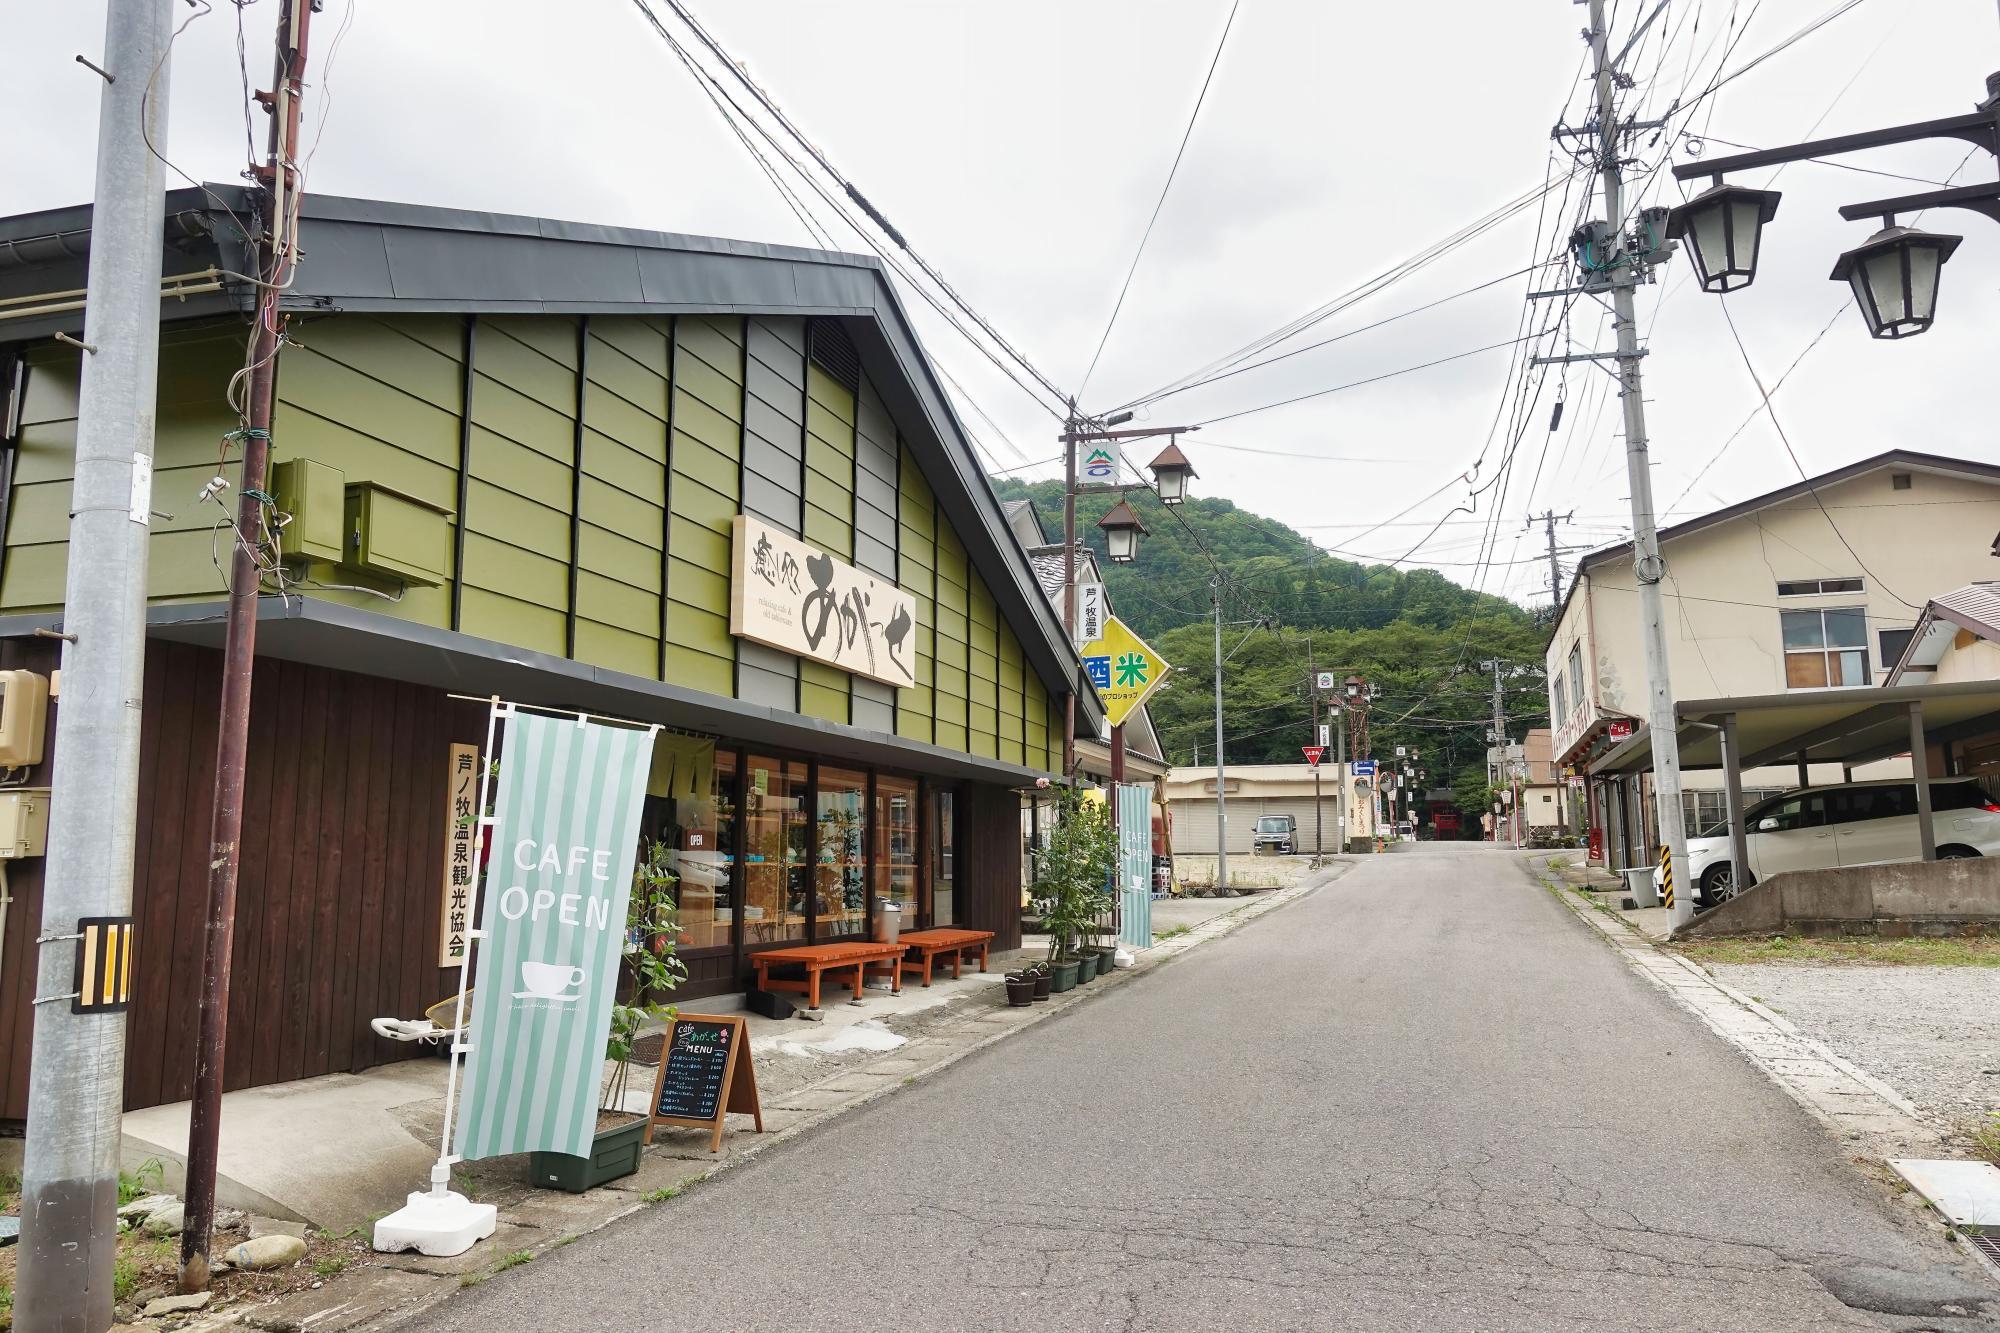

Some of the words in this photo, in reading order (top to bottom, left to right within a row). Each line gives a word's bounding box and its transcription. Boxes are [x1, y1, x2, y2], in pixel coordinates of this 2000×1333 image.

[1085, 588, 1097, 637] 芦ノ牧温泉
[690, 834, 703, 846] OPEN
[1125, 830, 1147, 845] CAFE
[449, 754, 473, 957] 芦ノ牧温泉観光協会
[514, 839, 612, 881] CAFE
[1124, 848, 1149, 864] OPEN
[500, 886, 610, 931] OPEN
[685, 1045, 713, 1054] MENU
